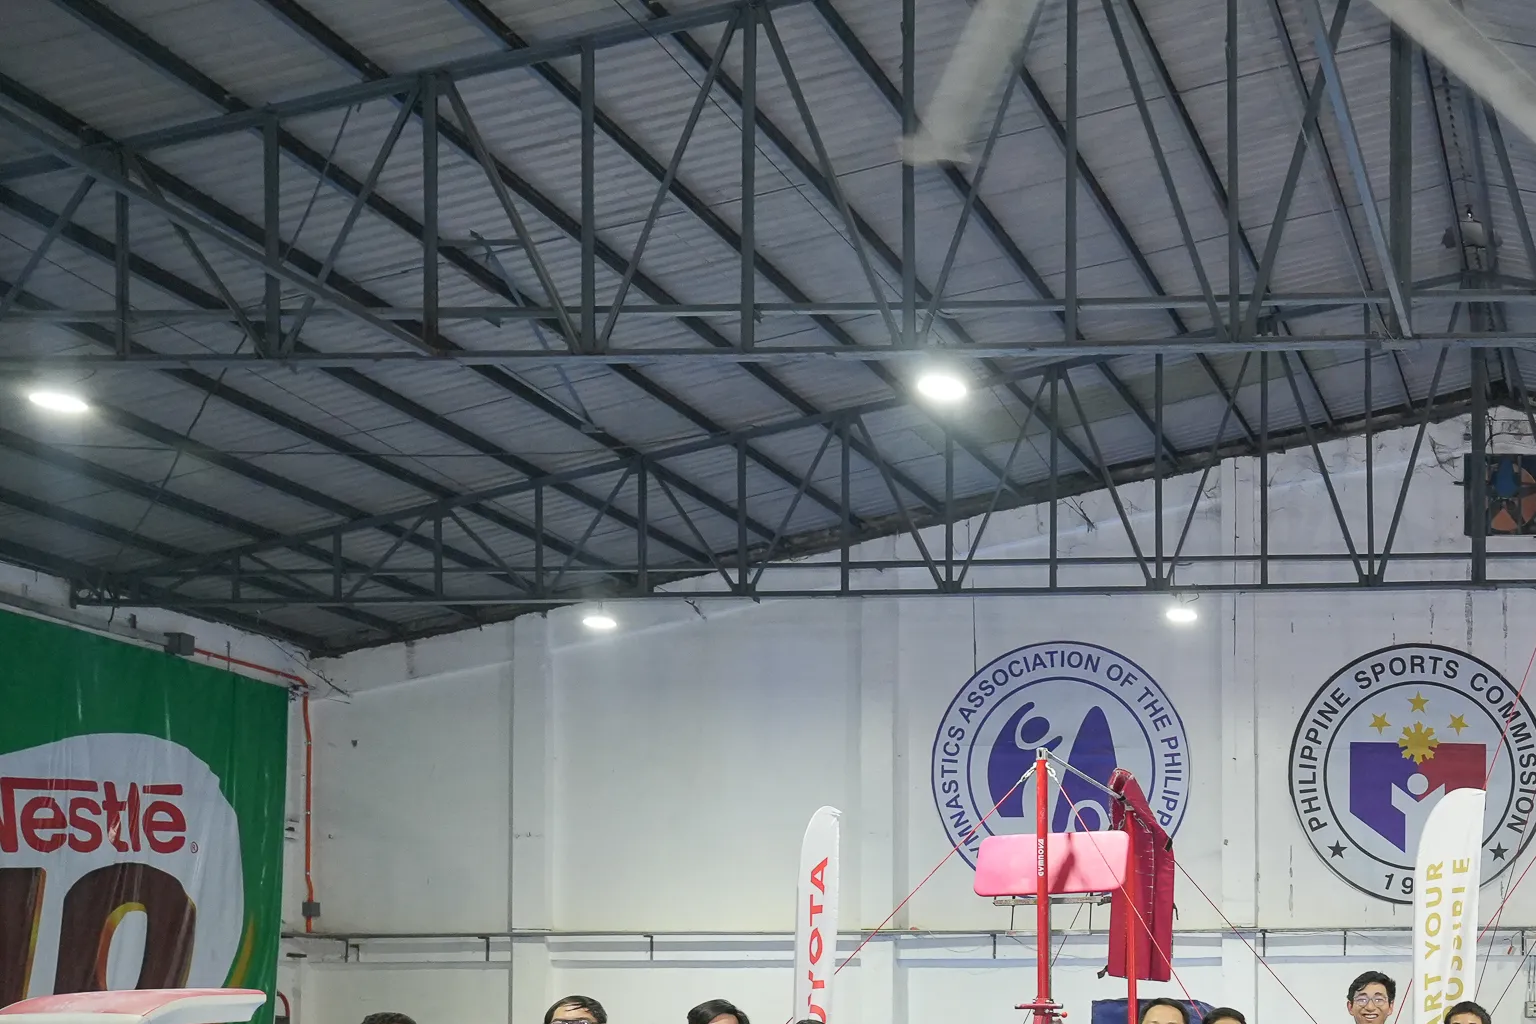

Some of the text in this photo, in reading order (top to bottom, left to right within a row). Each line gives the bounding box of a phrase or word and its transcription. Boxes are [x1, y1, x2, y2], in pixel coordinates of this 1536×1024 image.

[941, 650, 1182, 859] MNASTICS ASSOCIATION OF THE PHILIPP
[1298, 688, 1351, 833] PHILIPPINE
[1354, 655, 1460, 690] SPORTS
[1384, 873, 1414, 895] 19
[1425, 861, 1444, 960] YOUR
